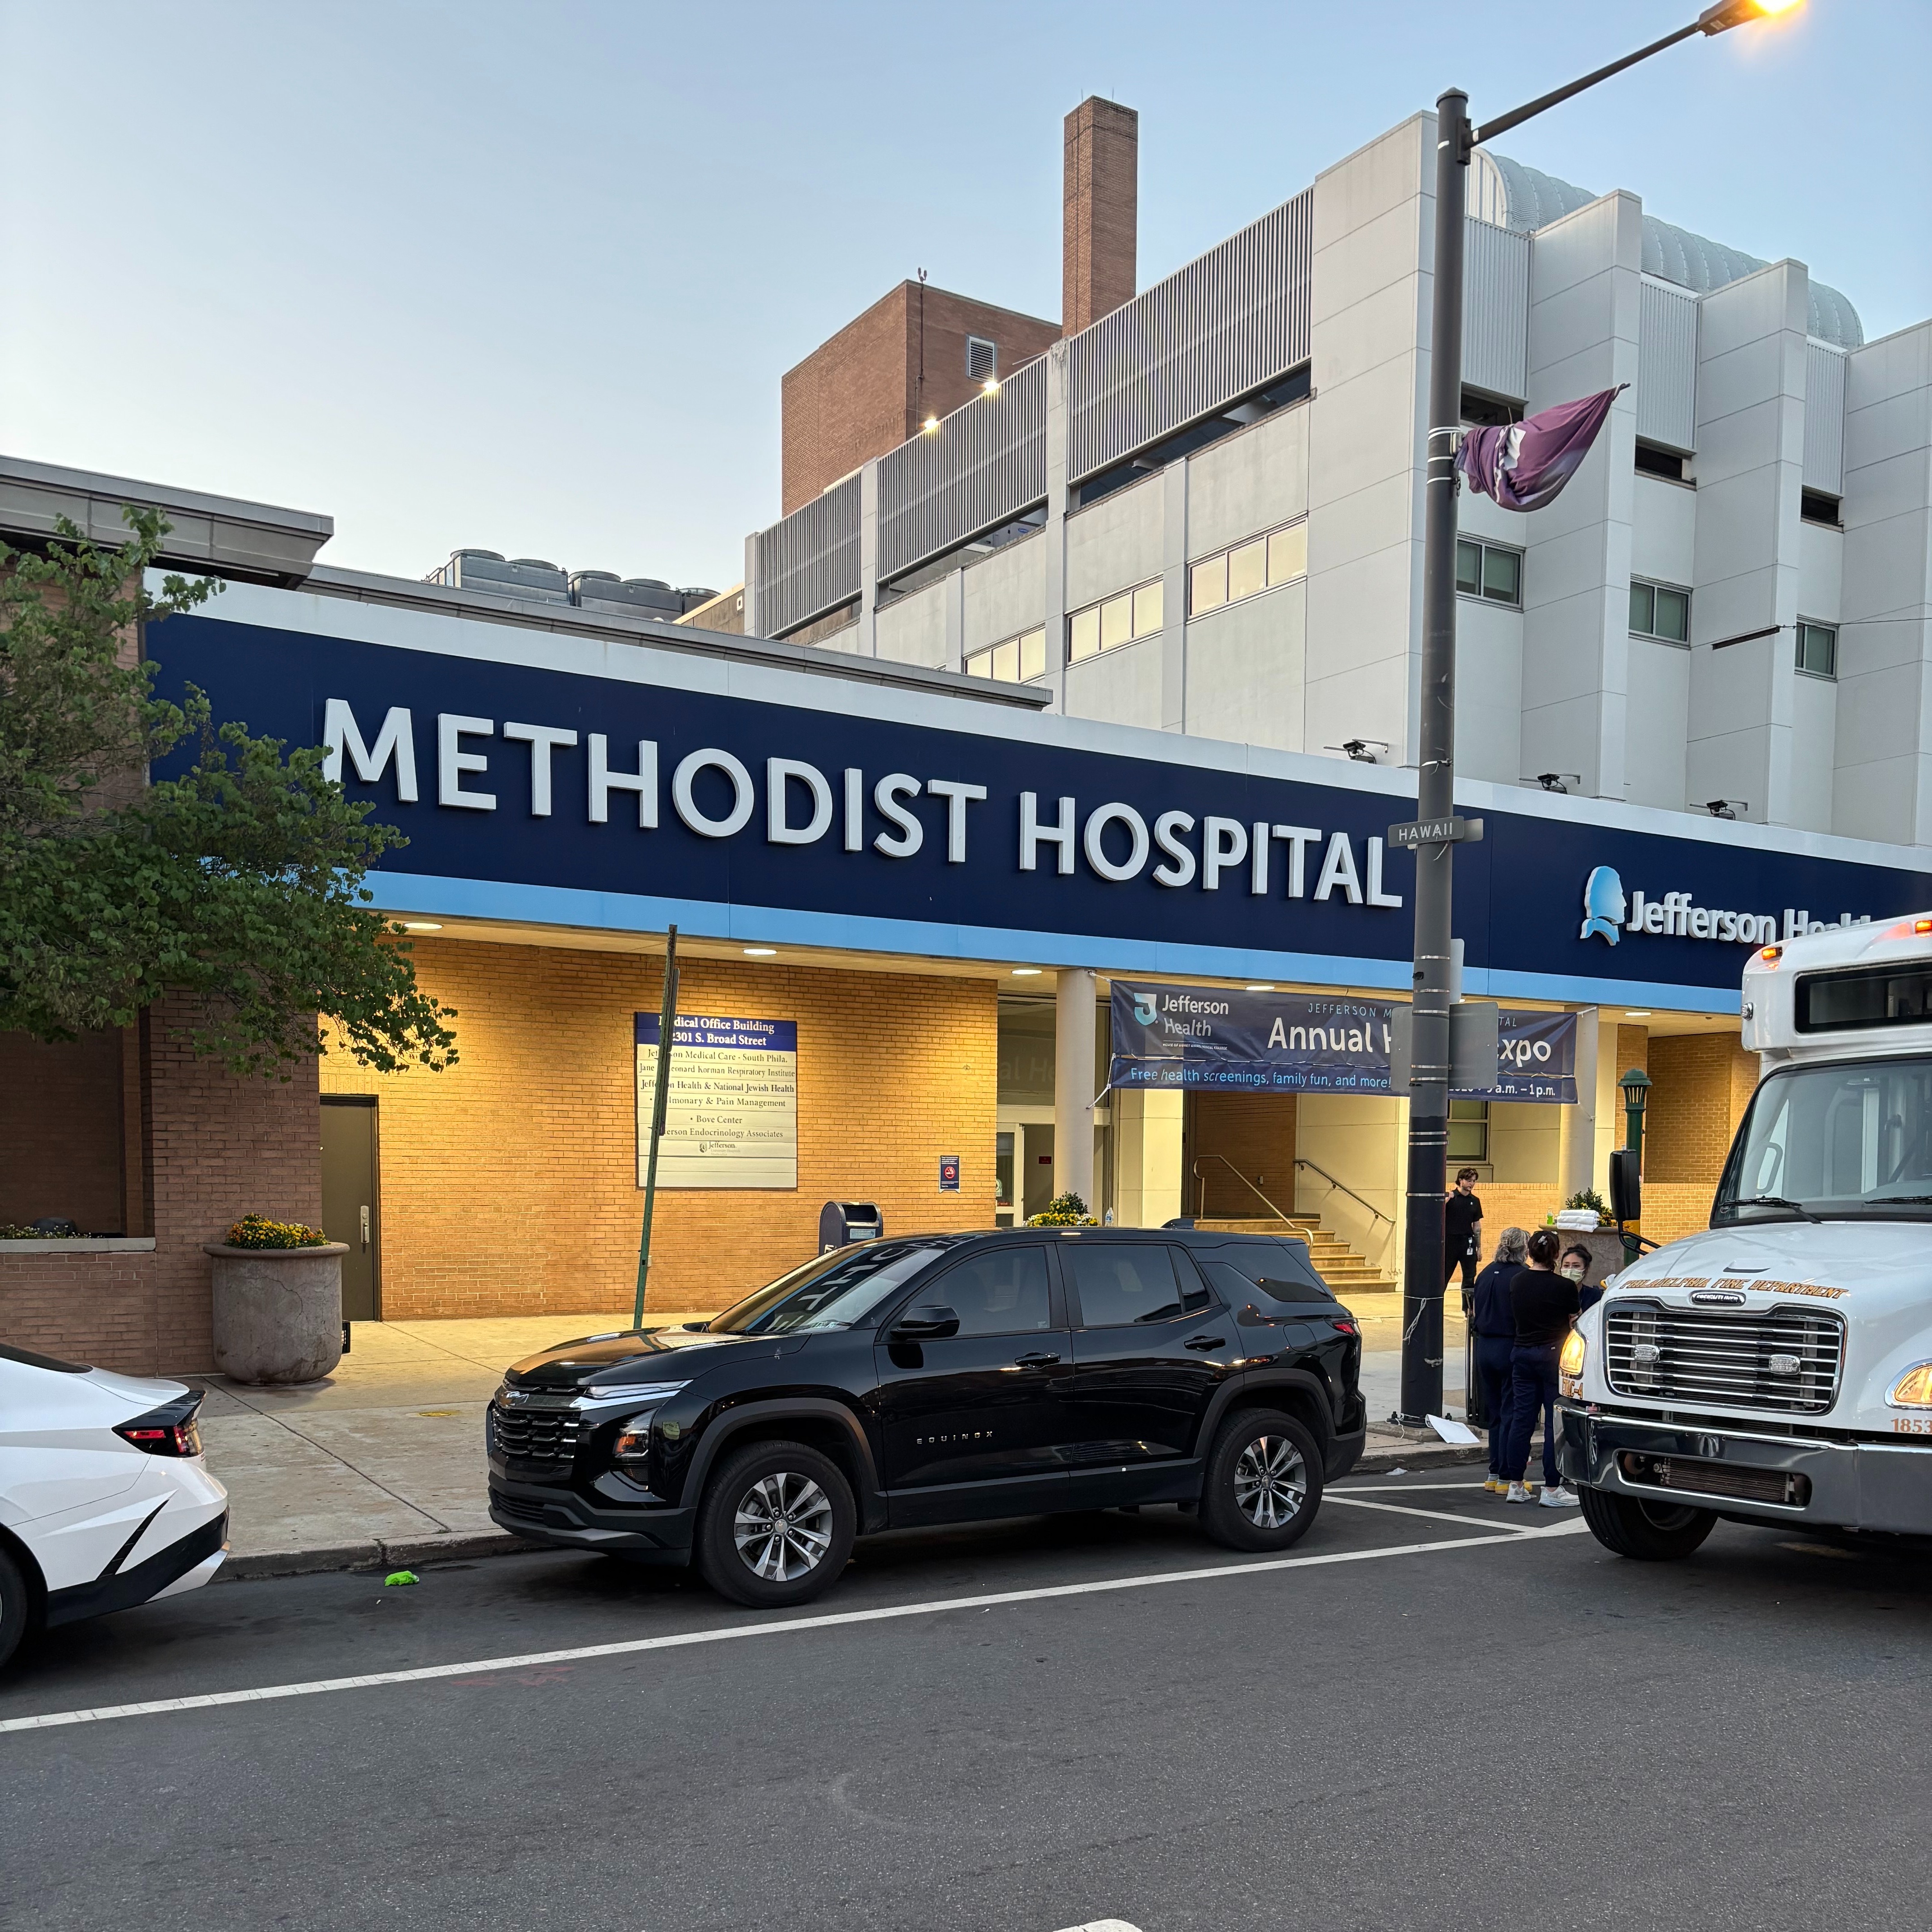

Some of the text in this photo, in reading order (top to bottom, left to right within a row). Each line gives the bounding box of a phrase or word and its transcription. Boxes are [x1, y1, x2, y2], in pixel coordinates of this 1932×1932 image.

[322, 698, 1402, 907] METHODIST HOSPITAL
[1399, 822, 1453, 841] HAWAII
[1626, 891, 1776, 945] Jefferson
[1162, 994, 1229, 1015] Jefferson
[1308, 1003, 1376, 1017] JEFFERSON
[658, 1016, 775, 1035] dical Office Building
[1164, 1017, 1212, 1037] Health
[1267, 1017, 1373, 1053] Annual
[695, 1033, 704, 1043] S.
[707, 1033, 737, 1044] Broad
[739, 1035, 767, 1046] Street
[648, 1049, 683, 1058] Jefon
[685, 1051, 716, 1059] Medical
[718, 1052, 736, 1060] Care
[743, 1053, 764, 1062] South
[767, 1055, 787, 1063] Phila.
[1497, 1039, 1552, 1067] xpo
[639, 1063, 654, 1073] Jane
[671, 1065, 695, 1073] eonard
[727, 1067, 766, 1078] Respiratory
[768, 1069, 795, 1077] Institute
[1131, 1067, 1391, 1088] Free health screenings, family fun, and more!
[677, 1081, 702, 1090] Health
[713, 1082, 744, 1091] National
[745, 1084, 768, 1093] Jewish
[771, 1085, 795, 1093] Health
[1495, 1085, 1518, 1094] a.m.
[669, 1096, 703, 1107] lmonary
[716, 1097, 734, 1105] Pain
[737, 1098, 786, 1109] Management
[690, 1128, 745, 1139] Endocrinology
[1619, 1277, 1849, 1299] PHILADELPHIA FIRE DEPARTMENT
[916, 1431, 993, 1444] EQUINOX
